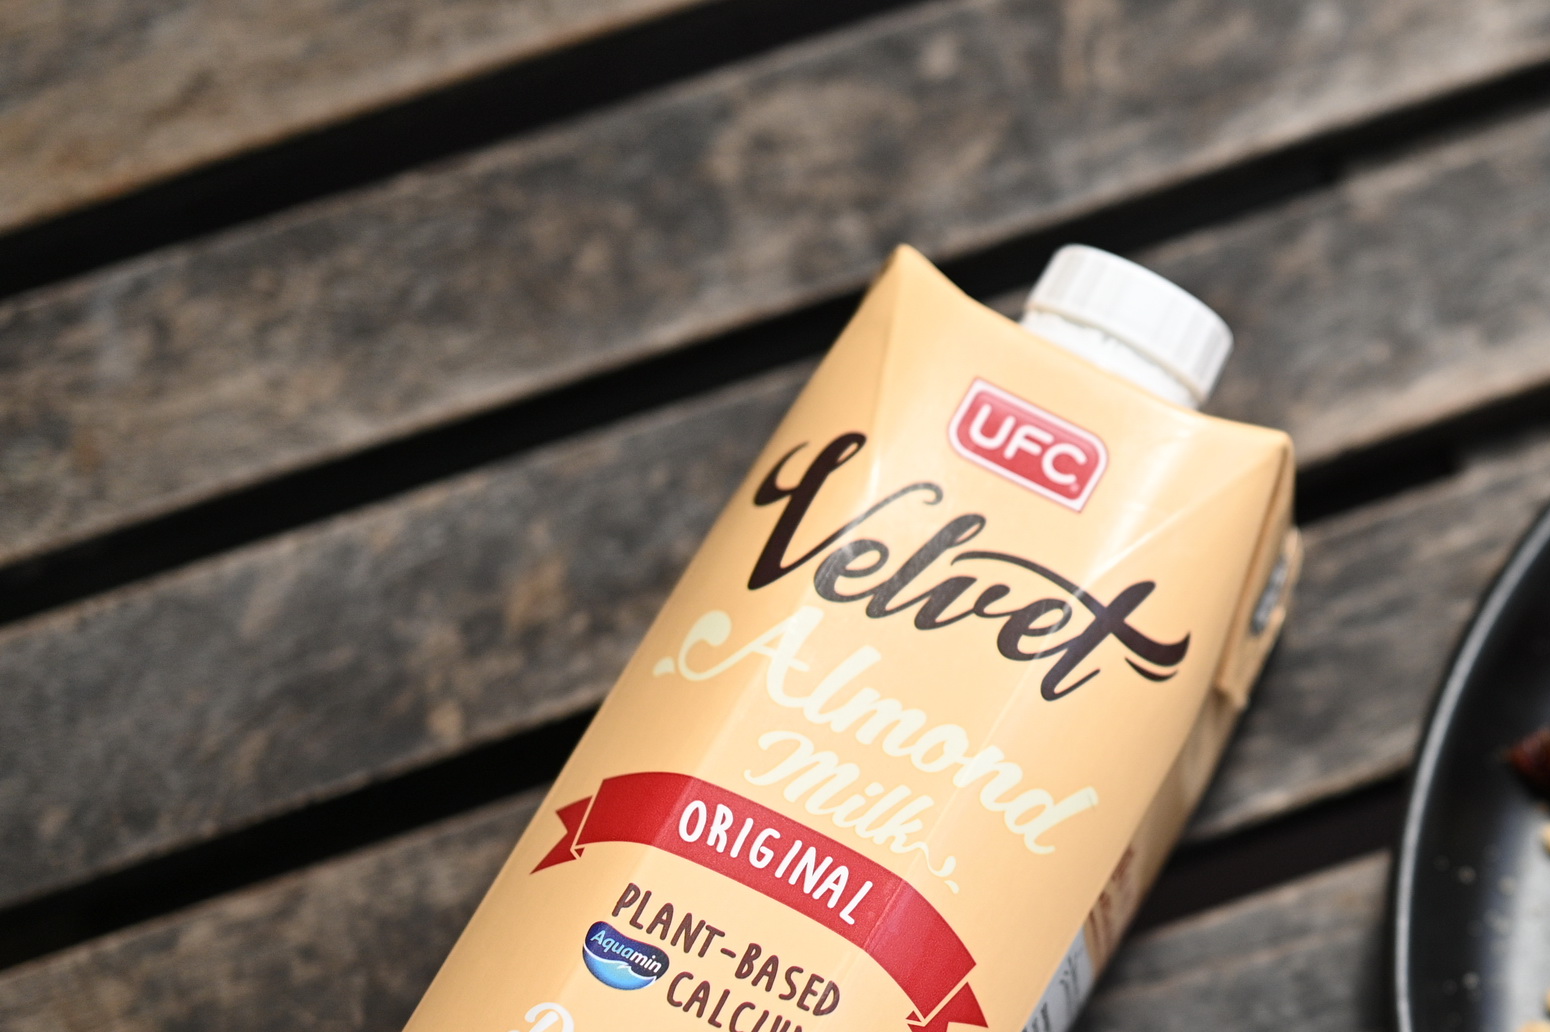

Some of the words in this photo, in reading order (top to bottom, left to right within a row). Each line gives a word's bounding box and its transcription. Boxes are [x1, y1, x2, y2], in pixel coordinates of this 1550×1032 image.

[969, 403, 1087, 485] UFC
[748, 432, 1190, 701] Velvet
[654, 606, 1098, 855] Almond
[677, 800, 874, 926] ORIGINAL
[744, 731, 957, 882] Milk
[590, 930, 662, 973] Aquamin
[611, 882, 840, 1016] PLANT-BASED
